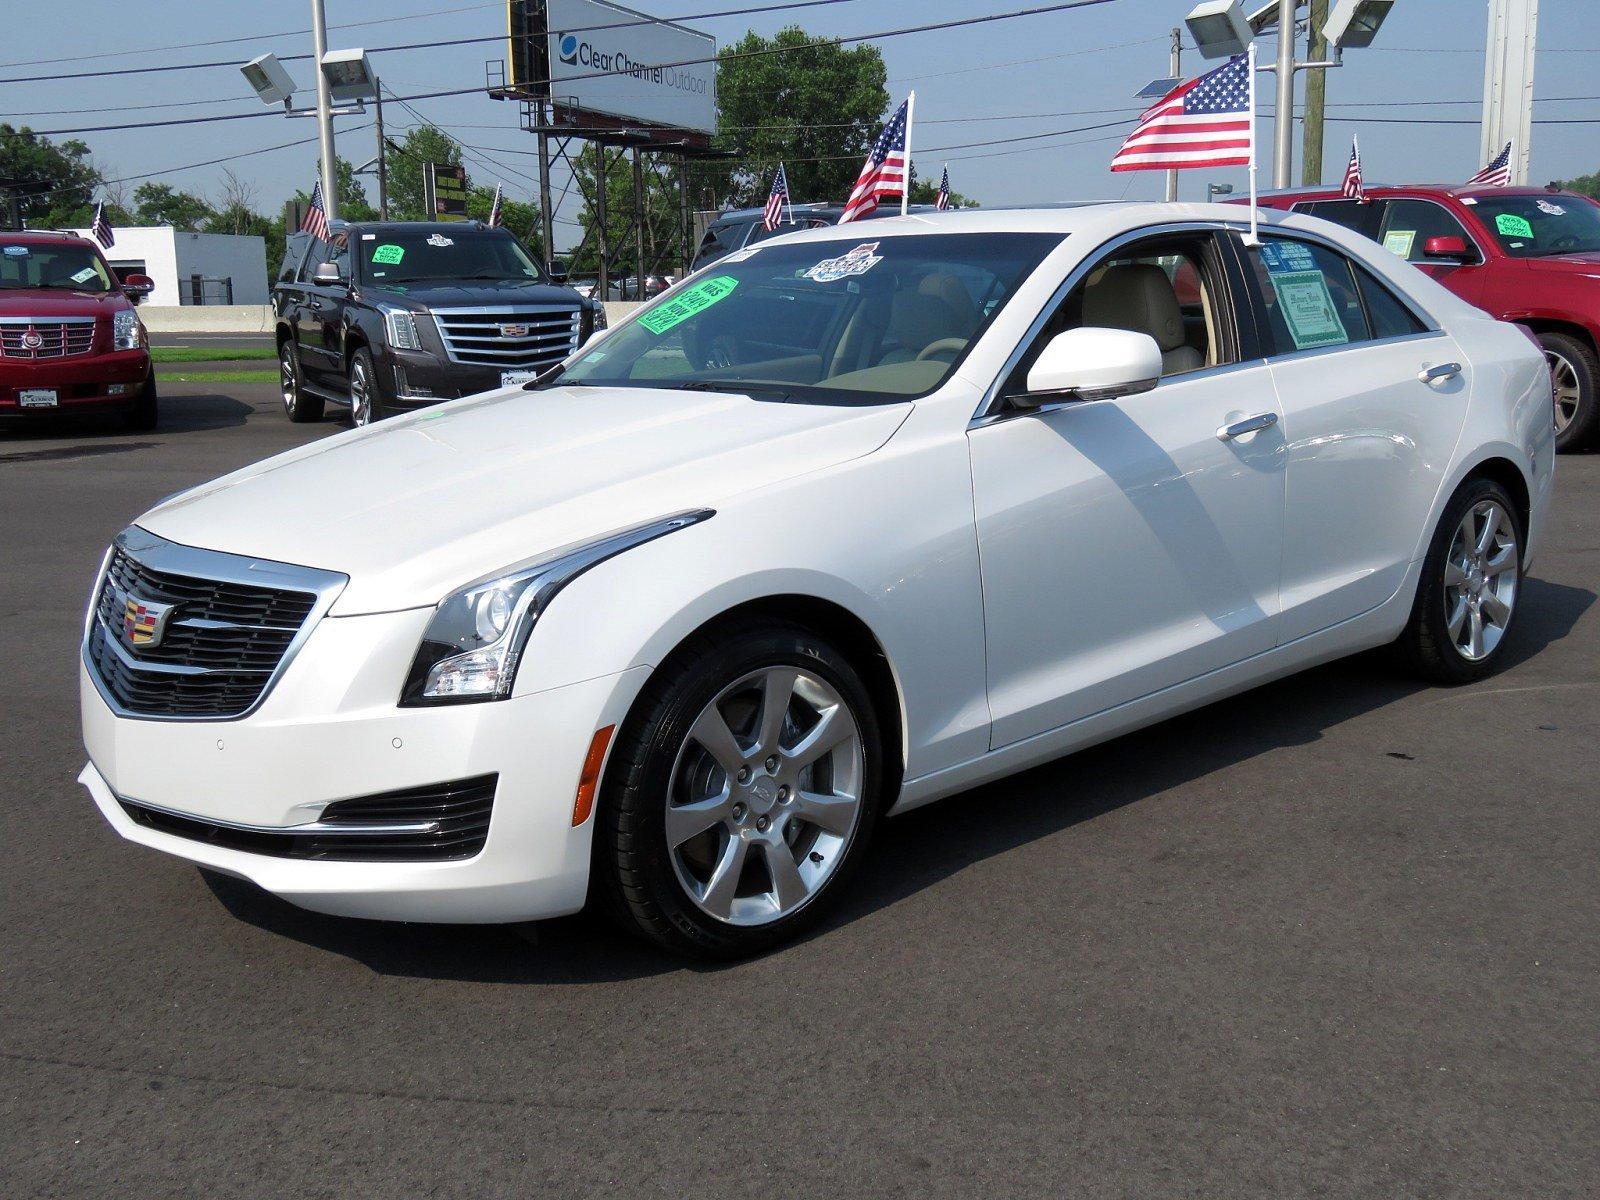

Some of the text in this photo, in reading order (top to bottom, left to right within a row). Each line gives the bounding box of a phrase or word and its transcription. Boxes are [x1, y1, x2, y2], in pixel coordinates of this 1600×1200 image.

[579, 42, 707, 95] Clear Channel Outdoor
